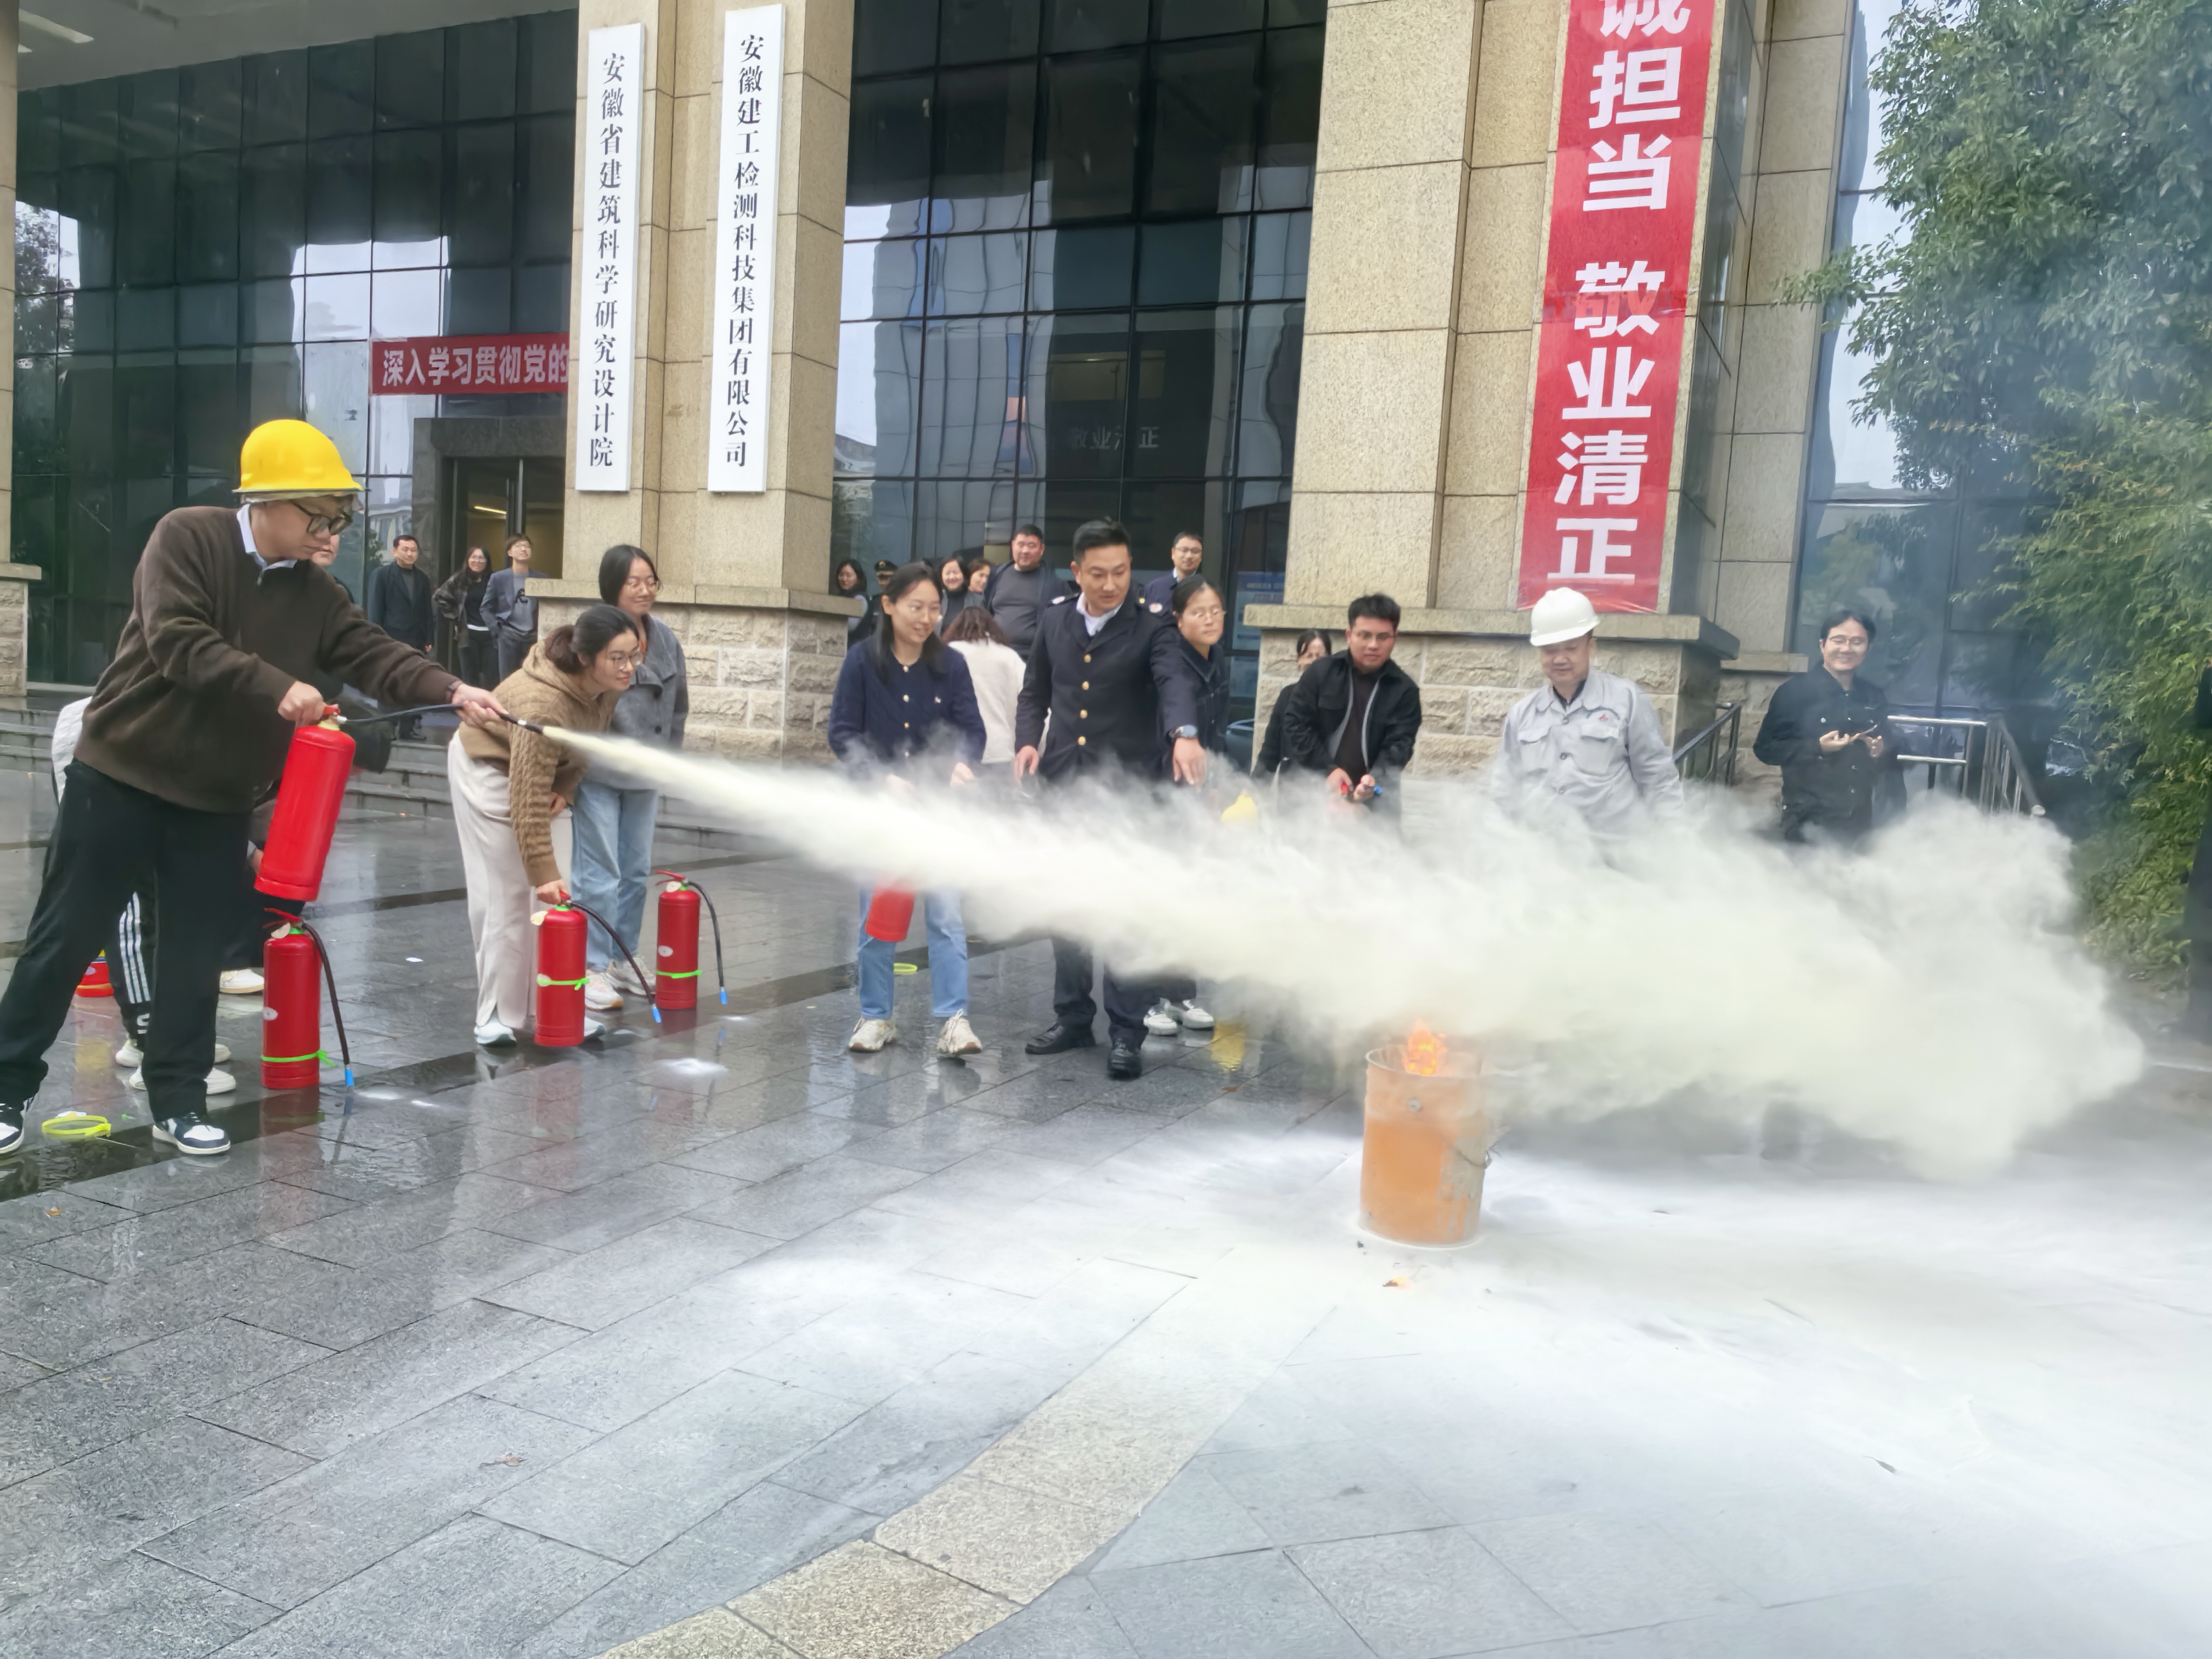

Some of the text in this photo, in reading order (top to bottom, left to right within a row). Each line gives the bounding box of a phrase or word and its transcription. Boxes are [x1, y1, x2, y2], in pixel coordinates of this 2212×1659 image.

[382, 343, 569, 387] 深入学习贯彻党的
[590, 52, 625, 468] 安徽省建筑科学研究设计院
[725, 34, 765, 468] 安徽建工检测科技集团有限公司
[1547, 259, 1666, 583] 敬业清正
